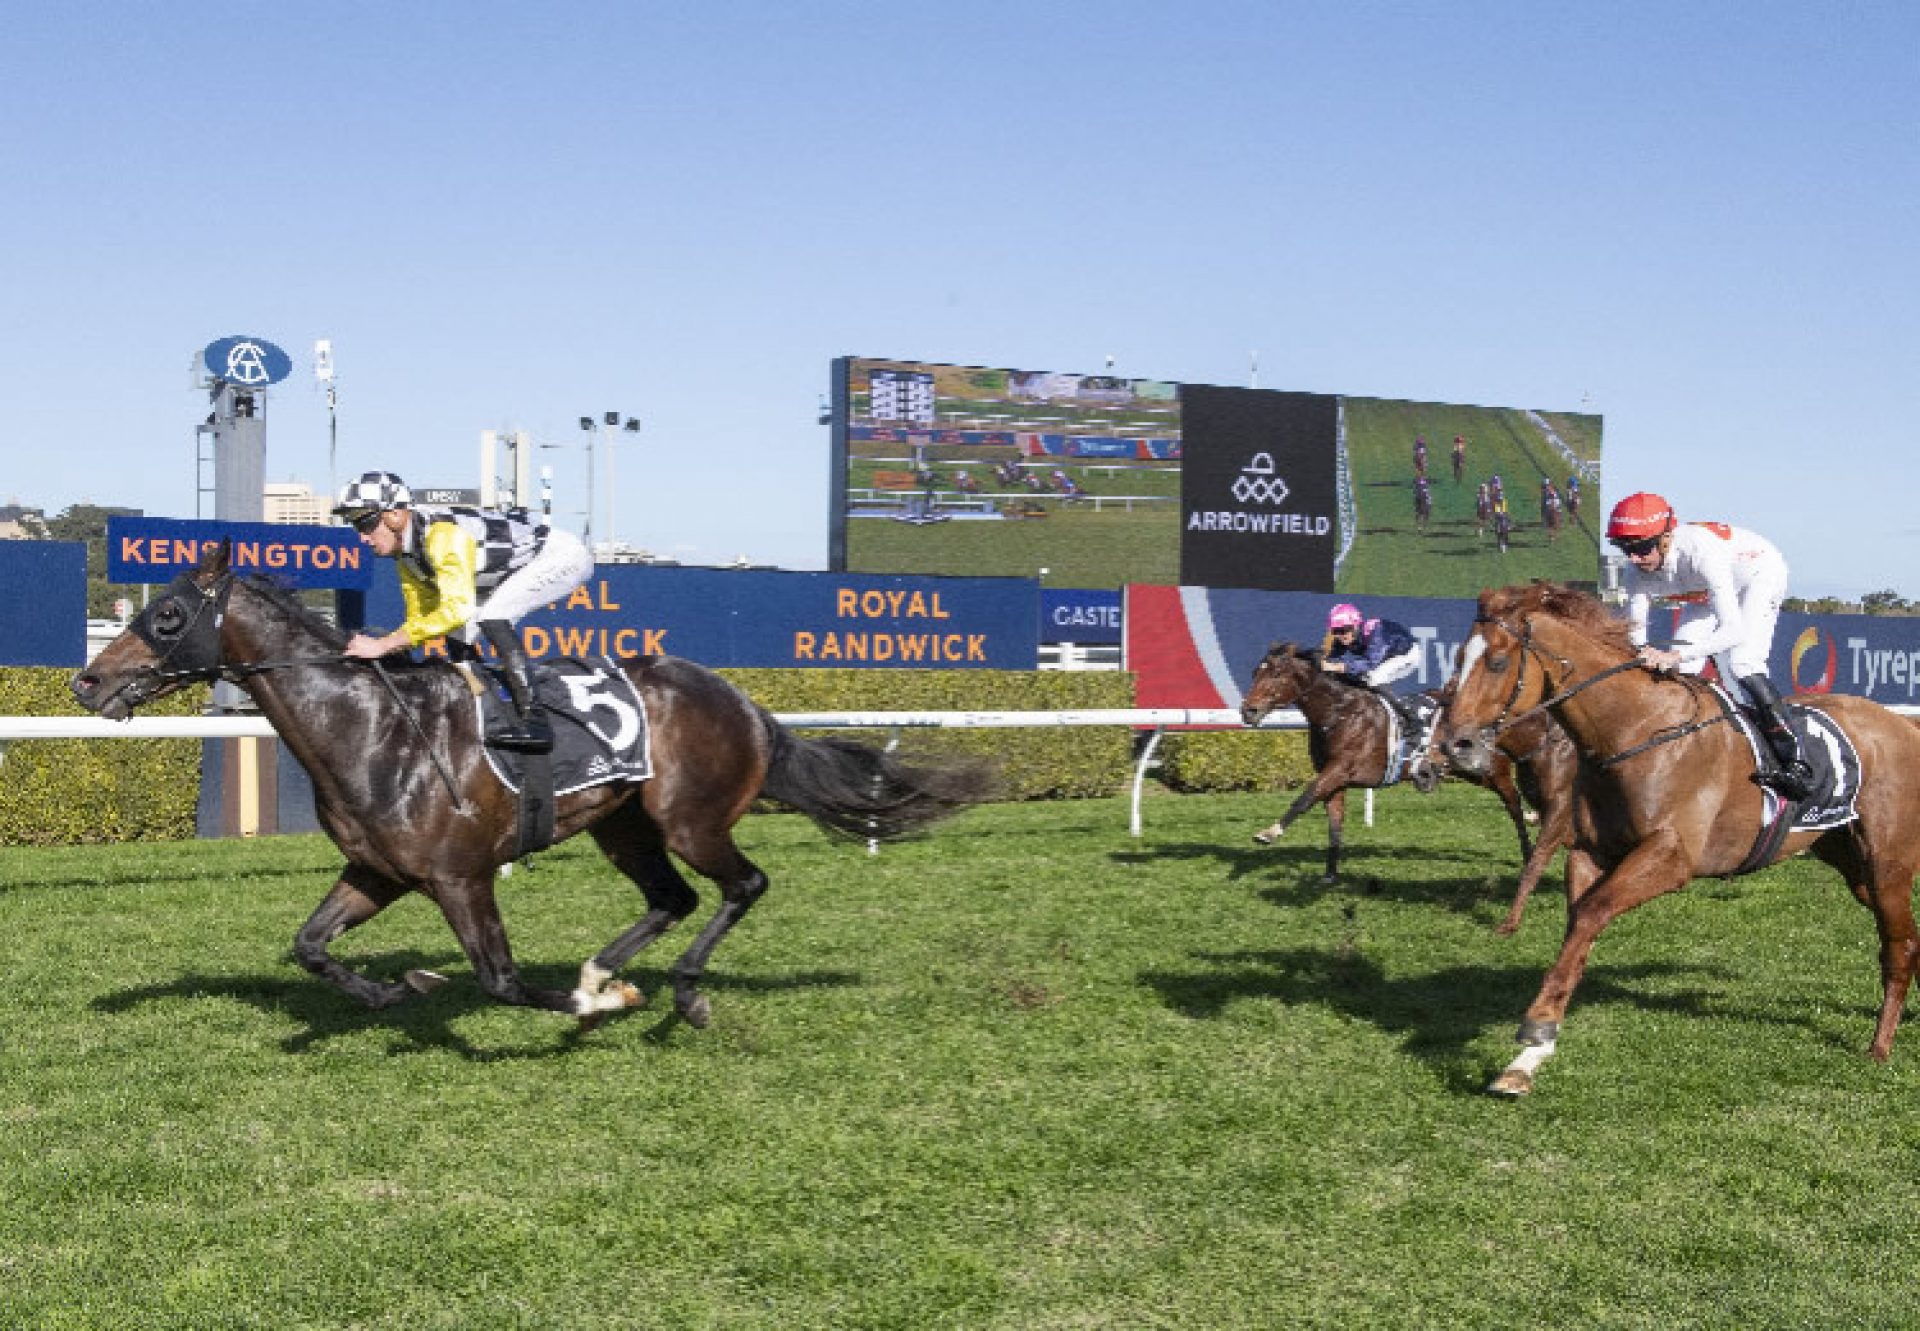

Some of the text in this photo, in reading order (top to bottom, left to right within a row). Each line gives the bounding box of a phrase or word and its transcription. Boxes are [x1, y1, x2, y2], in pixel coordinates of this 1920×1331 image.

[1188, 511, 1331, 536] ARROWFIELD
[837, 588, 950, 618] ROYAL
[424, 626, 668, 659] RDWICK
[794, 631, 986, 661] RANDWICK
[1848, 637, 1920, 696] Tyrep
[560, 668, 641, 753] 5
[1806, 714, 1847, 797] 1
